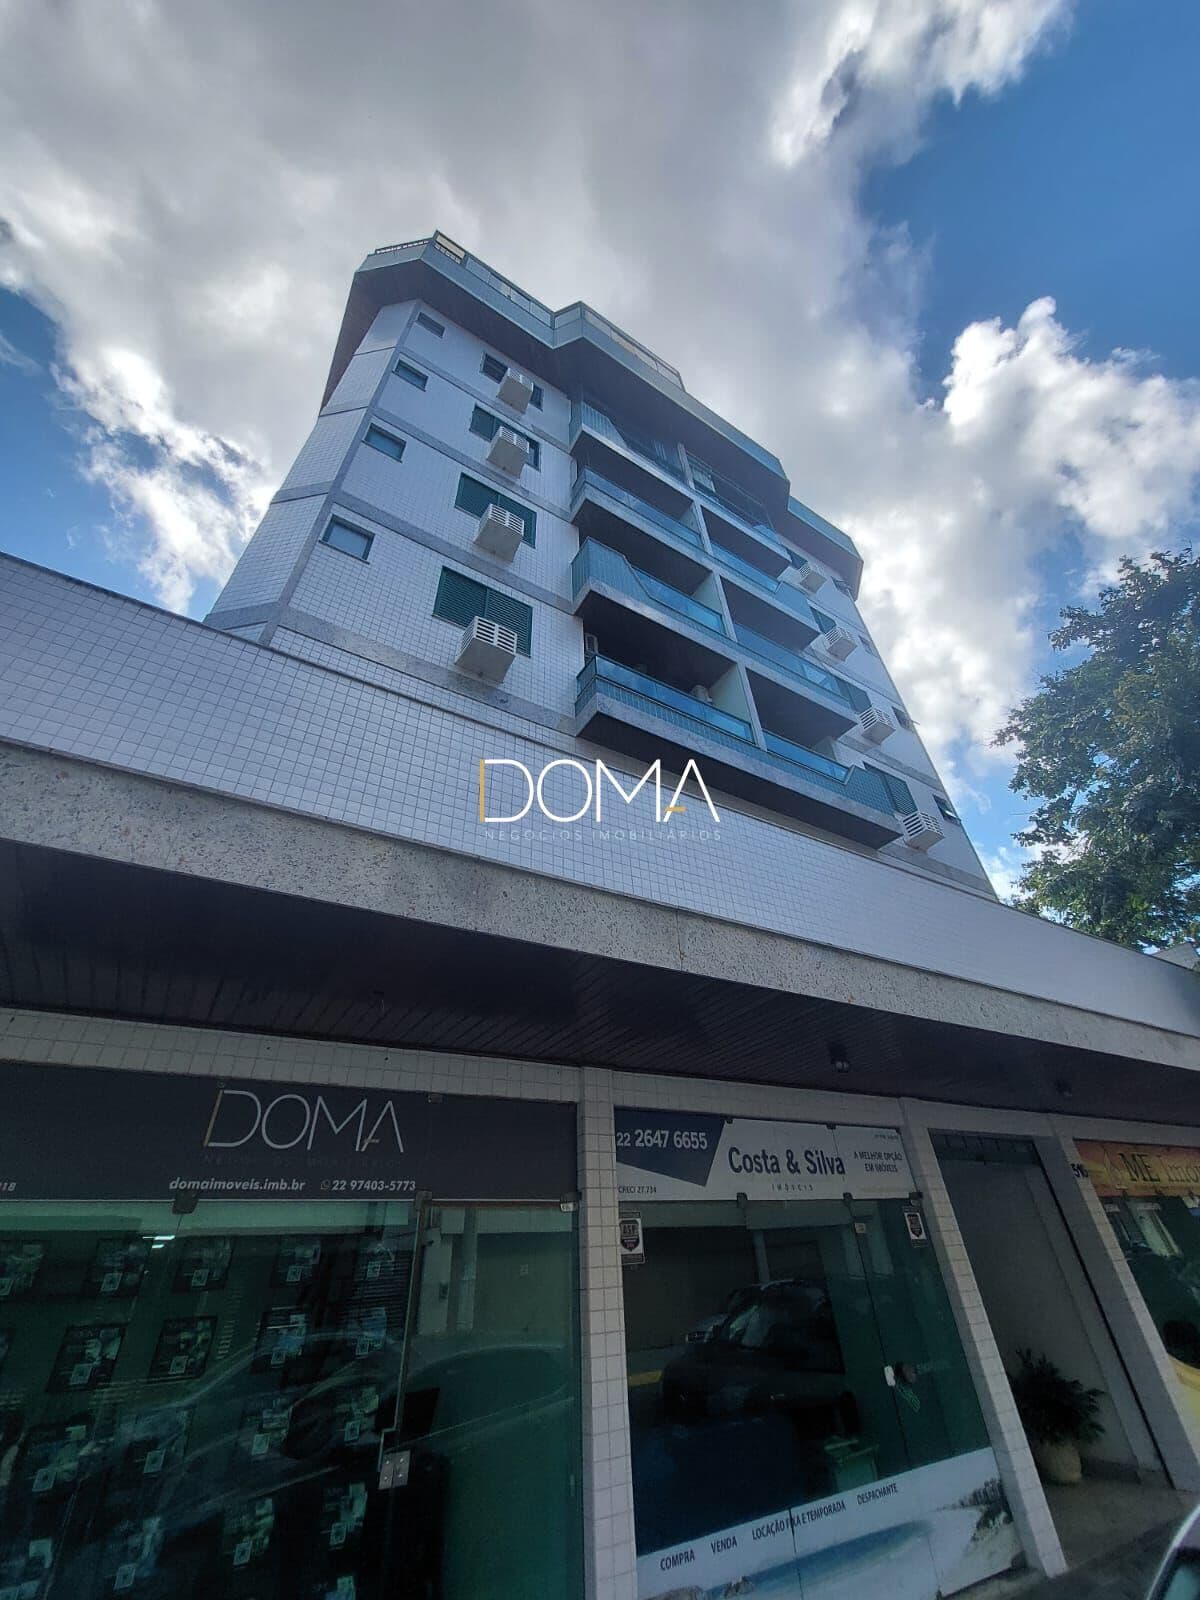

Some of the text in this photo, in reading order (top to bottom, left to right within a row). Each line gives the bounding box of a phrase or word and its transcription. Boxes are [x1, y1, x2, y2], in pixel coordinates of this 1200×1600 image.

[203, 1088, 404, 1153] DOMA
[617, 1129, 707, 1149] 22 2647 6655
[728, 1146, 846, 1175] Costa & Silva
[1118, 1152, 1161, 1182] ME
[0, 1181, 18, 1193] 18
[168, 1177, 306, 1191] domaimoveis.imb.br
[331, 1179, 417, 1192] 22 97403-5773
[856, 1482, 898, 1506] DESPACHANTE
[751, 1519, 785, 1540] LOCAÇÃO
[786, 1515, 801, 1529] FXA
[807, 1499, 847, 1523] TEMPORADA
[710, 1535, 738, 1555] VENDA
[660, 1549, 695, 1572] COMPRA
